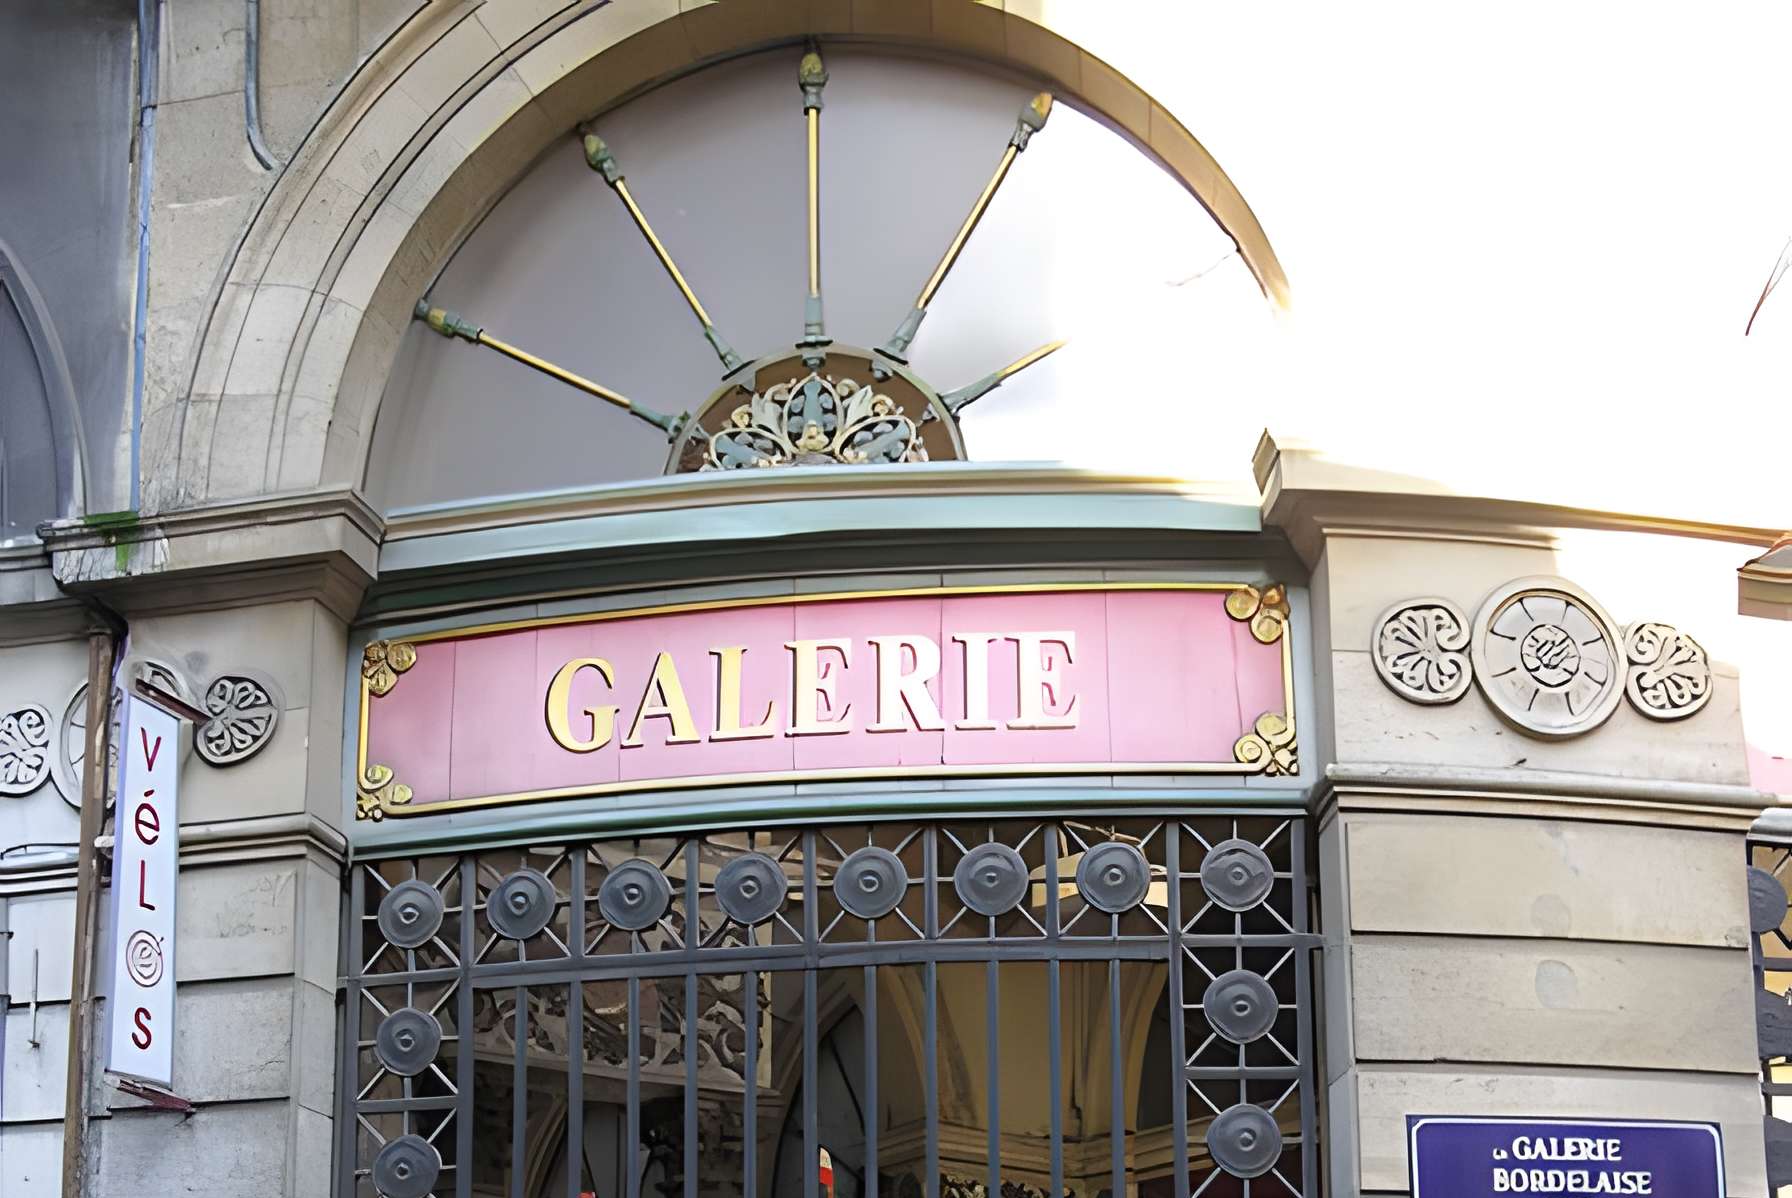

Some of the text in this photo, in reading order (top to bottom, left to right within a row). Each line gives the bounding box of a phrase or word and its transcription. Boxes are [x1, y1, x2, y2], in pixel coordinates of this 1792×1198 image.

[544, 631, 1077, 754] GALERIE
[1513, 1136, 1622, 1161] GALERIE
[1494, 1168, 1652, 1194] BORDELAISE
